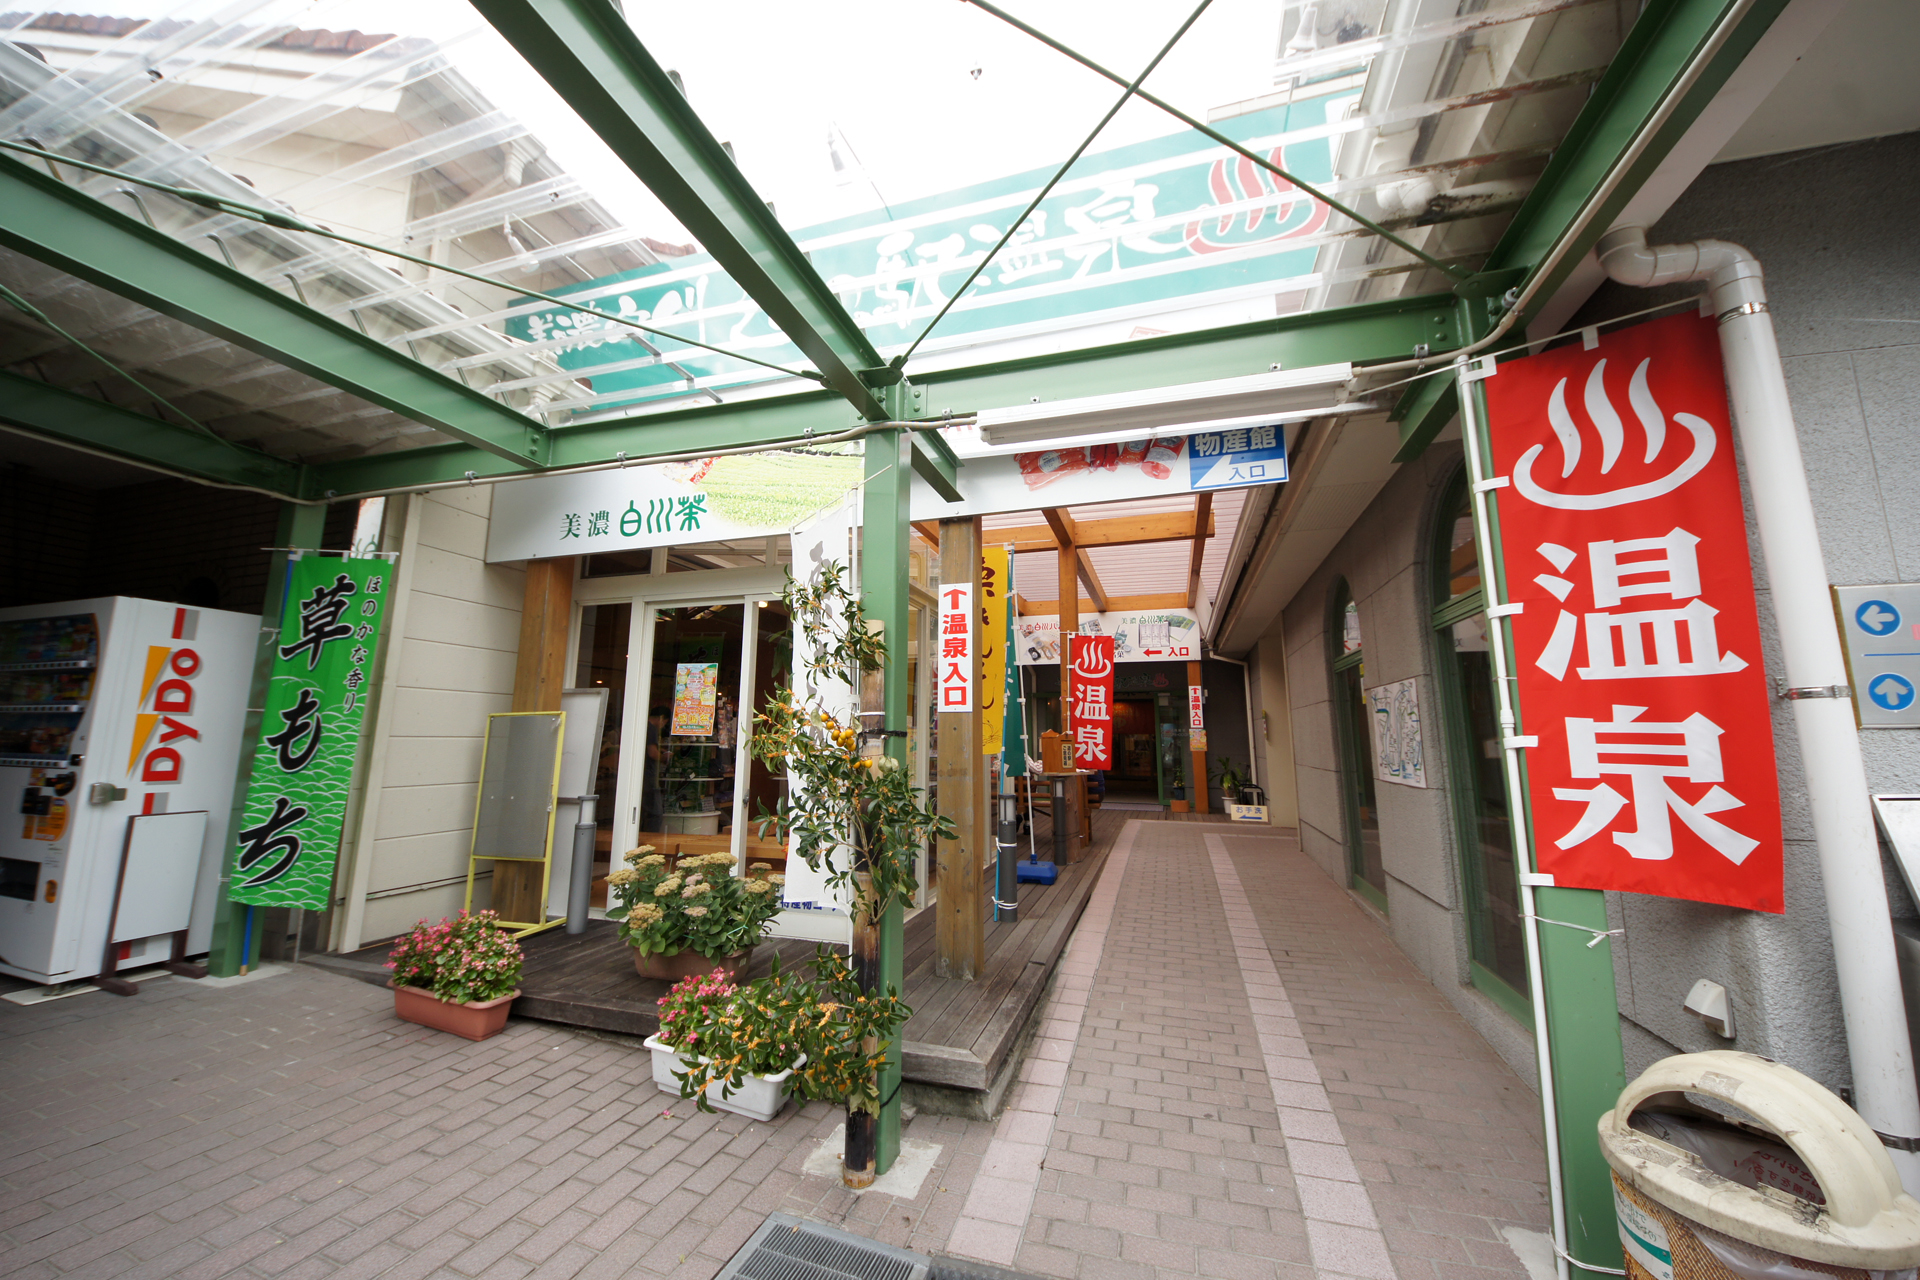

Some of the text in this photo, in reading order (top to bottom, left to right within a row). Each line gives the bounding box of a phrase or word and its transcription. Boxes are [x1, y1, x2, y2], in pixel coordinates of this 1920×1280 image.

[1194, 426, 1276, 457] 物産館
[1228, 464, 1266, 481] 入口
[559, 493, 708, 541] 美濃白川茶
[342, 575, 382, 714] ほのかな香り
[942, 613, 968, 707] 温泉入口
[1168, 646, 1190, 657] 入口
[141, 647, 202, 783] DyDo
[1074, 684, 1111, 763] 温泉
[1190, 695, 1202, 727] 温泉入口
[1533, 526, 1761, 866] 温泉
[229, 573, 357, 888] 草もち
[1235, 806, 1263, 815] お手洗
